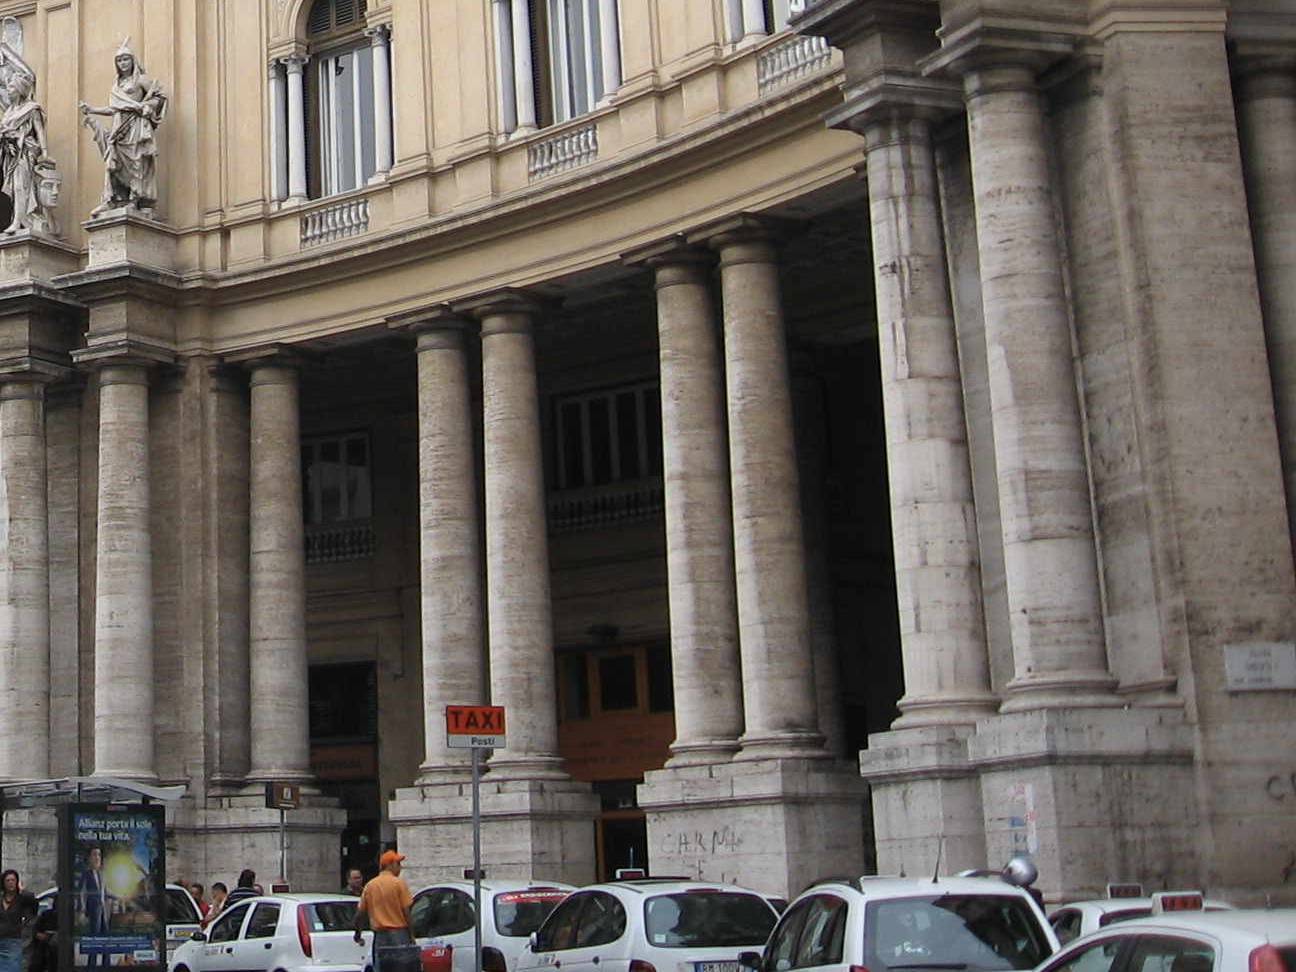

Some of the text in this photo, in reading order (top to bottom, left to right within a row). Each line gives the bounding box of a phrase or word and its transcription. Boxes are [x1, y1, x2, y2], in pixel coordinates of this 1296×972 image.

[451, 711, 502, 729] TAXI
[471, 737, 495, 746] Posti
[78, 818, 105, 829] Allianz
[106, 819, 128, 831] porta
[136, 819, 153, 830] sole
[78, 829, 98, 840] nella
[99, 831, 112, 840] tua
